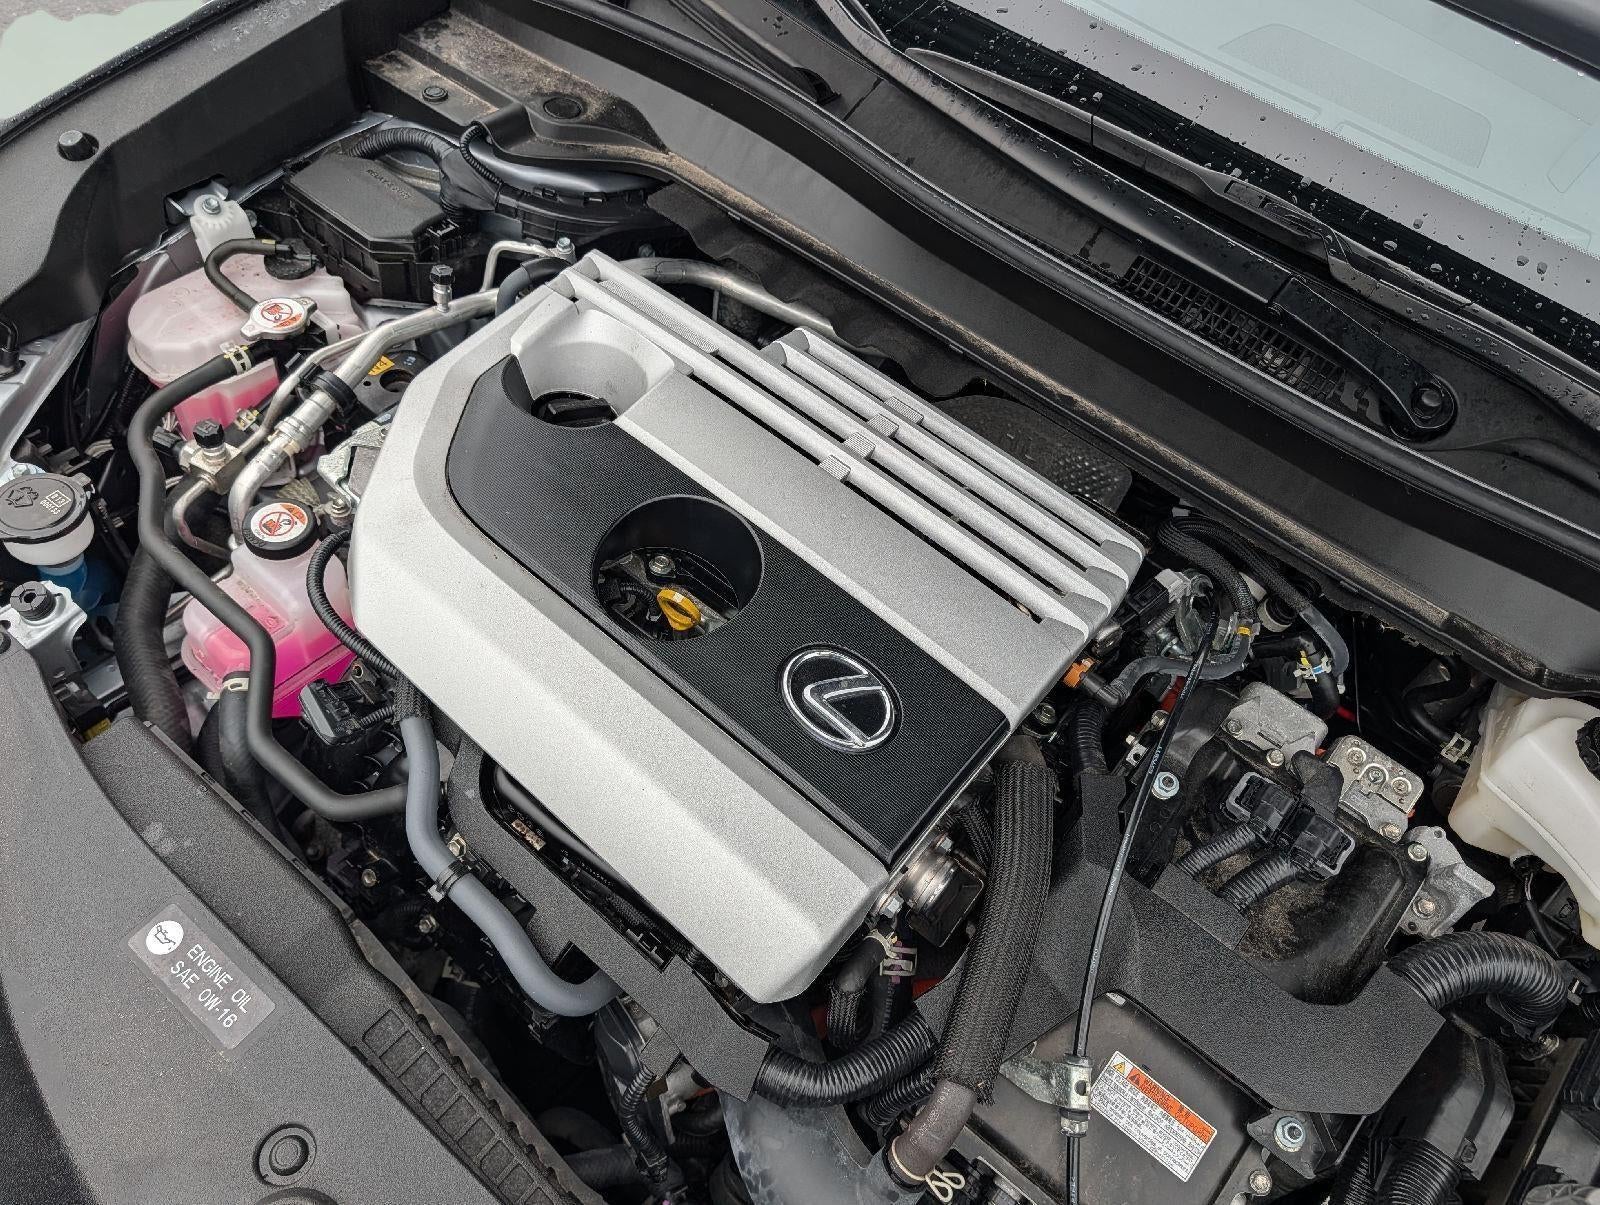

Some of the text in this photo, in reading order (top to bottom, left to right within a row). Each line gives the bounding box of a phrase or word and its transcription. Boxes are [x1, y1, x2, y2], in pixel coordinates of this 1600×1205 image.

[170, 960, 239, 1028] SAE 0W-16
[187, 944, 252, 1014] ENGINE OIL
[1142, 1077, 1170, 1101] WARNING
